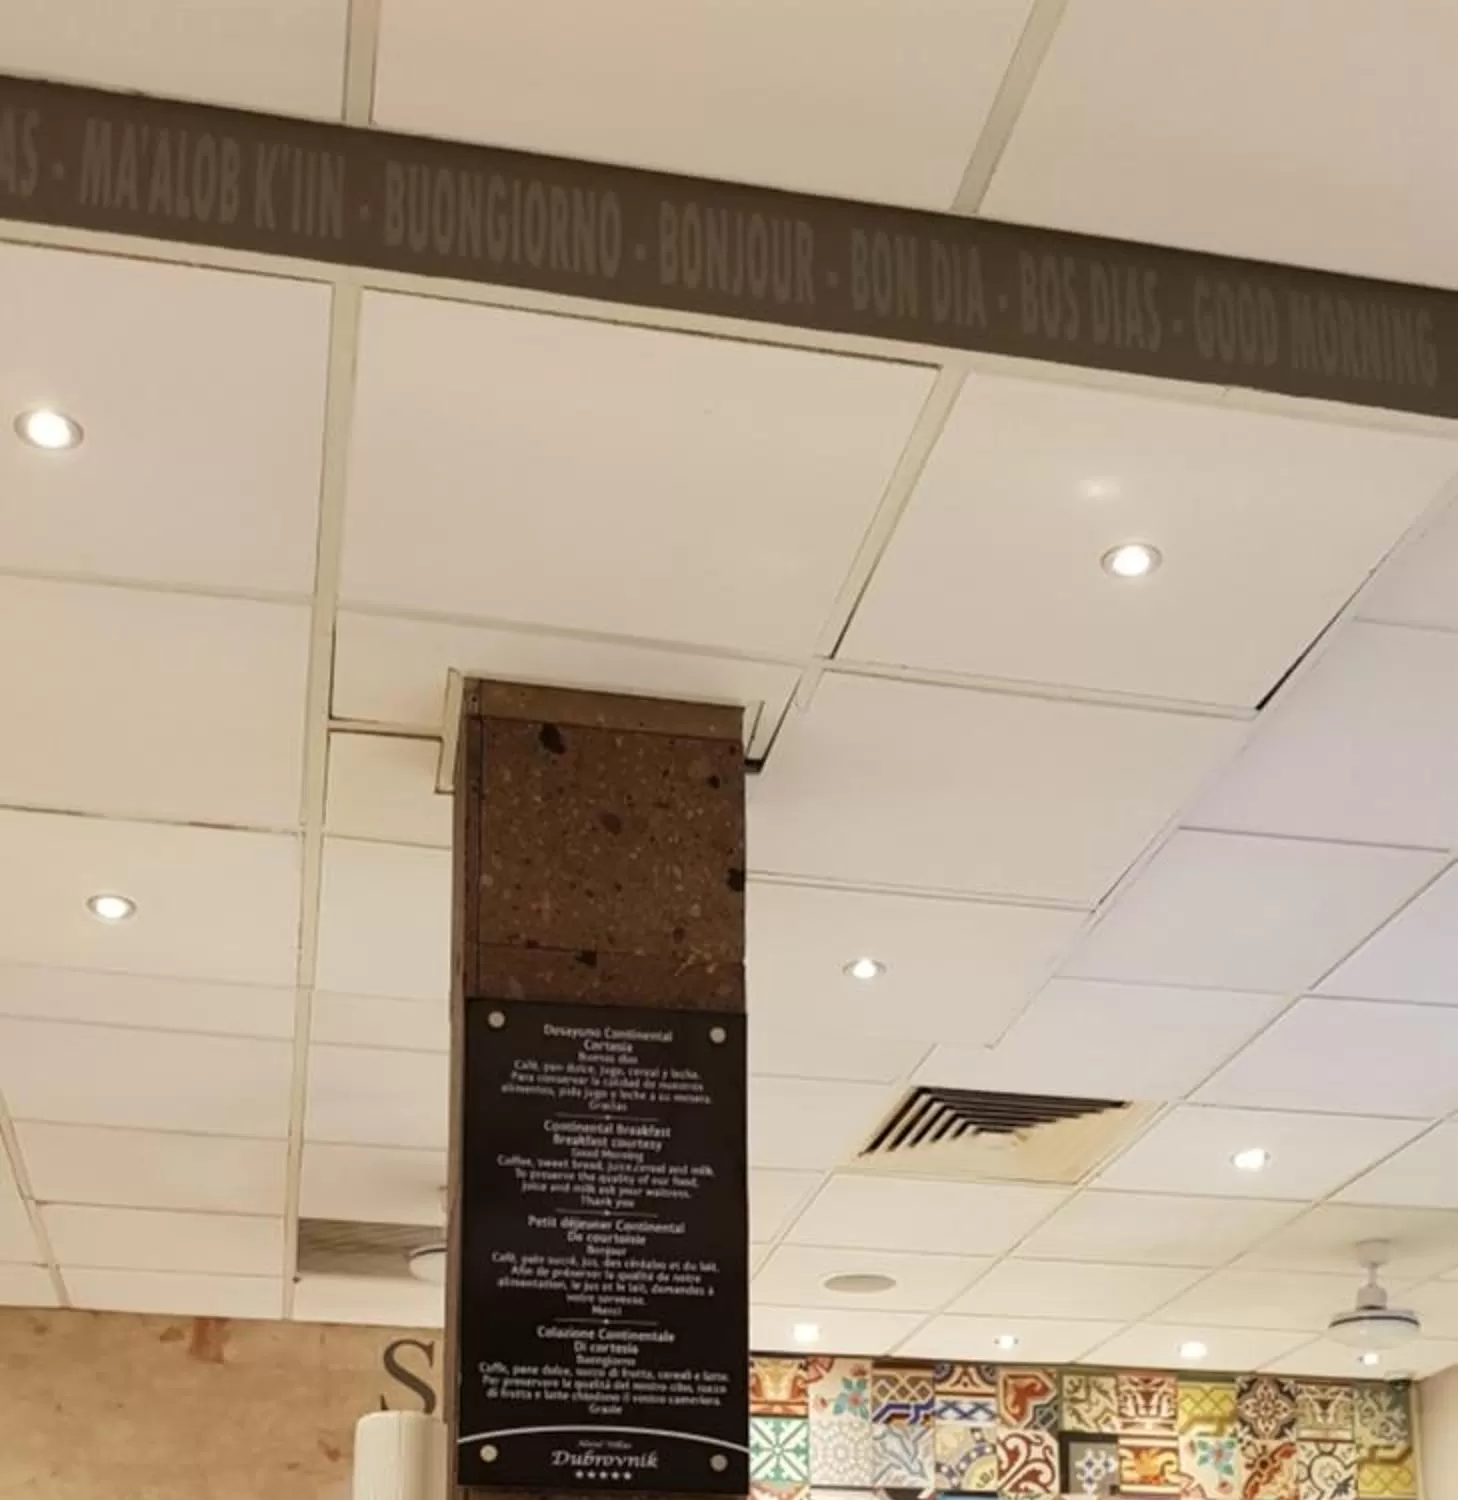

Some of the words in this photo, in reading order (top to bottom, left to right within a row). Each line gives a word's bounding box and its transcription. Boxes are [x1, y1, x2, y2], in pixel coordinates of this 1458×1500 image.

[80, 117, 240, 224] MA'ALOB
[253, 141, 346, 240] K'IIN
[384, 160, 623, 279] BUONGIORNO
[658, 200, 815, 304] BONJOUR
[850, 228, 919, 319] BON
[930, 239, 988, 328] DIA
[1018, 250, 1079, 341] BOS
[1089, 263, 1163, 353] DIAS
[1193, 275, 1279, 367] GOOD
[1288, 289, 1439, 388] MORNING
[543, 1023, 601, 1040] Desayuno
[603, 1026, 673, 1041] Continental
[627, 1065, 659, 1076] cereal
[510, 1071, 534, 1082] Para
[602, 1075, 640, 1087] calidad
[618, 1088, 646, 1099] leche
[543, 1119, 614, 1134] Continental
[615, 1122, 670, 1136] Breakfast
[552, 1132, 608, 1146] Breakfast
[610, 1135, 662, 1151] courtesy
[571, 1147, 599, 1158] Good
[600, 1148, 644, 1162] Morning
[537, 1157, 568, 1167] sweet
[668, 1162, 688, 1173] and
[529, 1171, 574, 1182] preserve
[577, 1171, 595, 1181] the
[597, 1172, 635, 1185] quality
[650, 1176, 669, 1184] our
[549, 1181, 570, 1192] and
[572, 1182, 596, 1193] milk
[598, 1183, 616, 1194] ask
[617, 1187, 642, 1197] your
[580, 1195, 612, 1206] Thank
[615, 1199, 635, 1209] you
[526, 1215, 557, 1227] Petit
[615, 1219, 686, 1233] Continental
[536, 1325, 595, 1339] Colazione
[597, 1327, 675, 1342] Continentale
[380, 1338, 437, 1414] S
[551, 1449, 659, 1469] Dubrovnik
